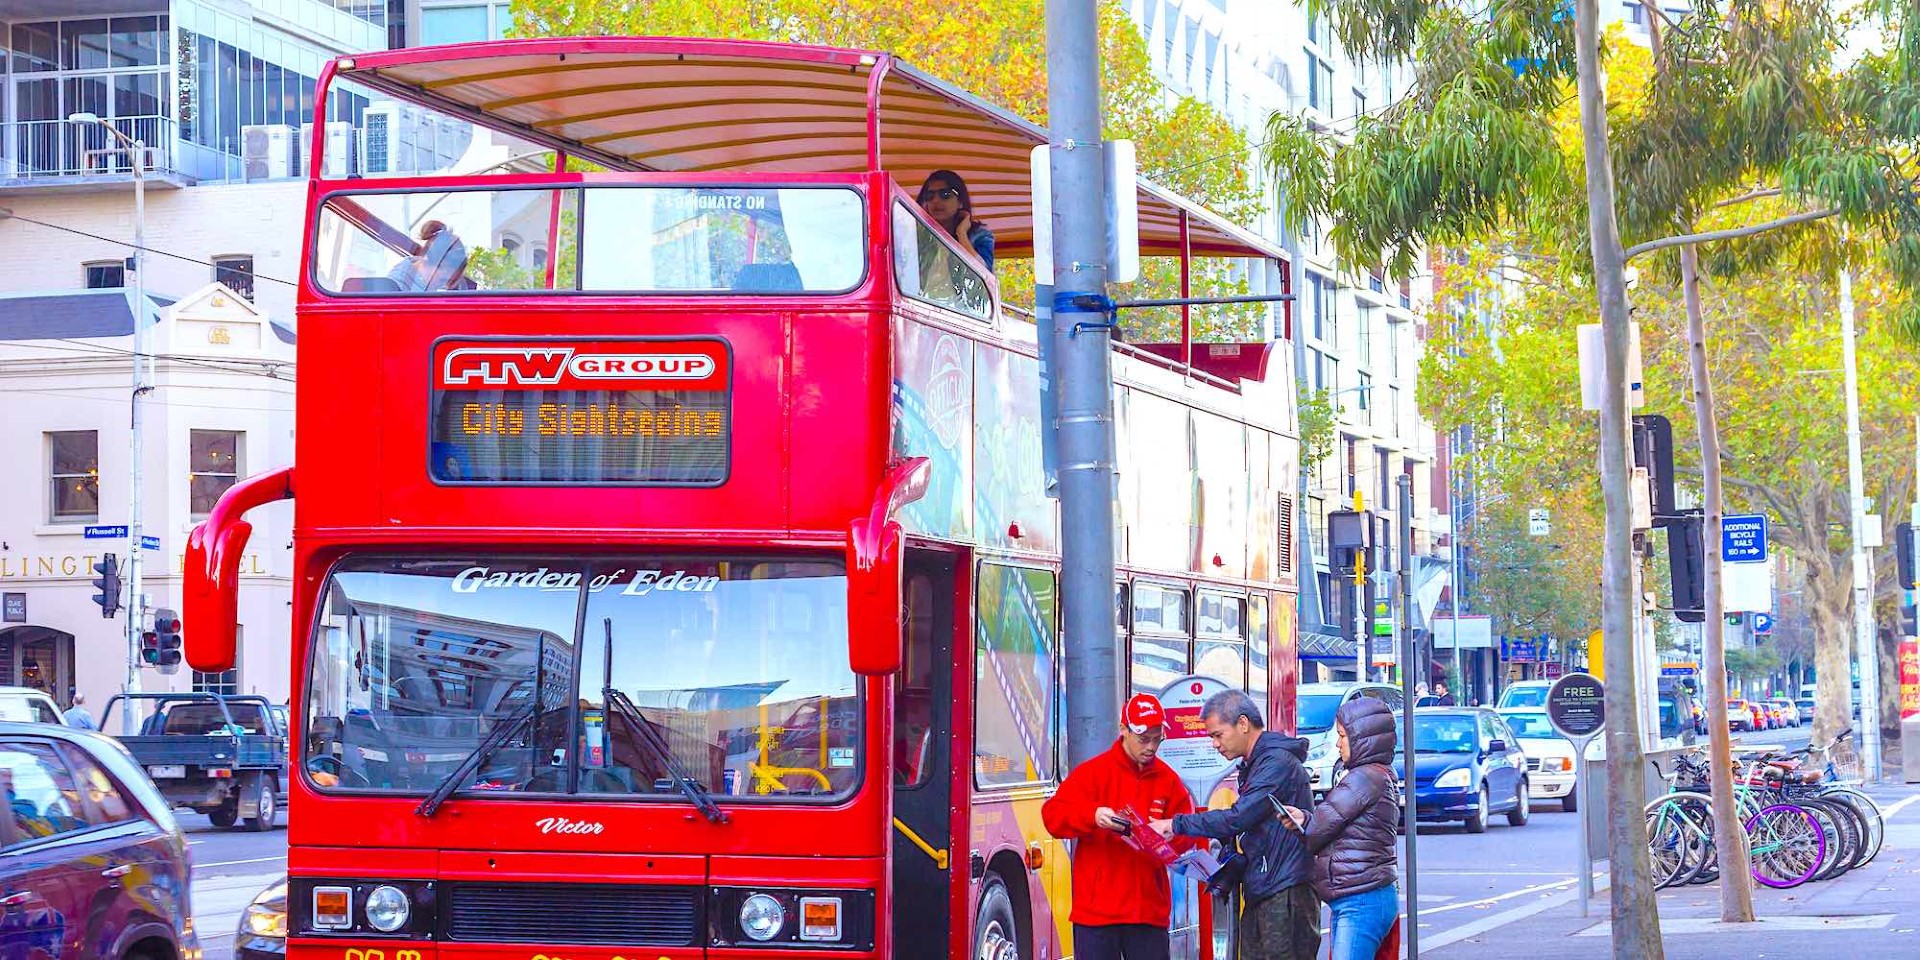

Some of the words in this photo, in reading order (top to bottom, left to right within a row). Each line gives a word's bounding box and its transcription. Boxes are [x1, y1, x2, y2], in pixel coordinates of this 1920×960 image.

[444, 347, 575, 384] FTW
[577, 359, 706, 373] GROUP
[462, 402, 523, 435] City
[537, 402, 722, 436] Sightseeing
[116, 527, 125, 535] St
[1724, 522, 1762, 531] ADDITIONAL
[1730, 531, 1757, 539] BICYCLE
[1733, 539, 1754, 547] RAILS
[451, 567, 581, 593] Garden
[588, 569, 626, 593] of
[618, 569, 720, 596] Eden
[1563, 687, 1595, 697] FREE
[535, 817, 605, 835] Victor
